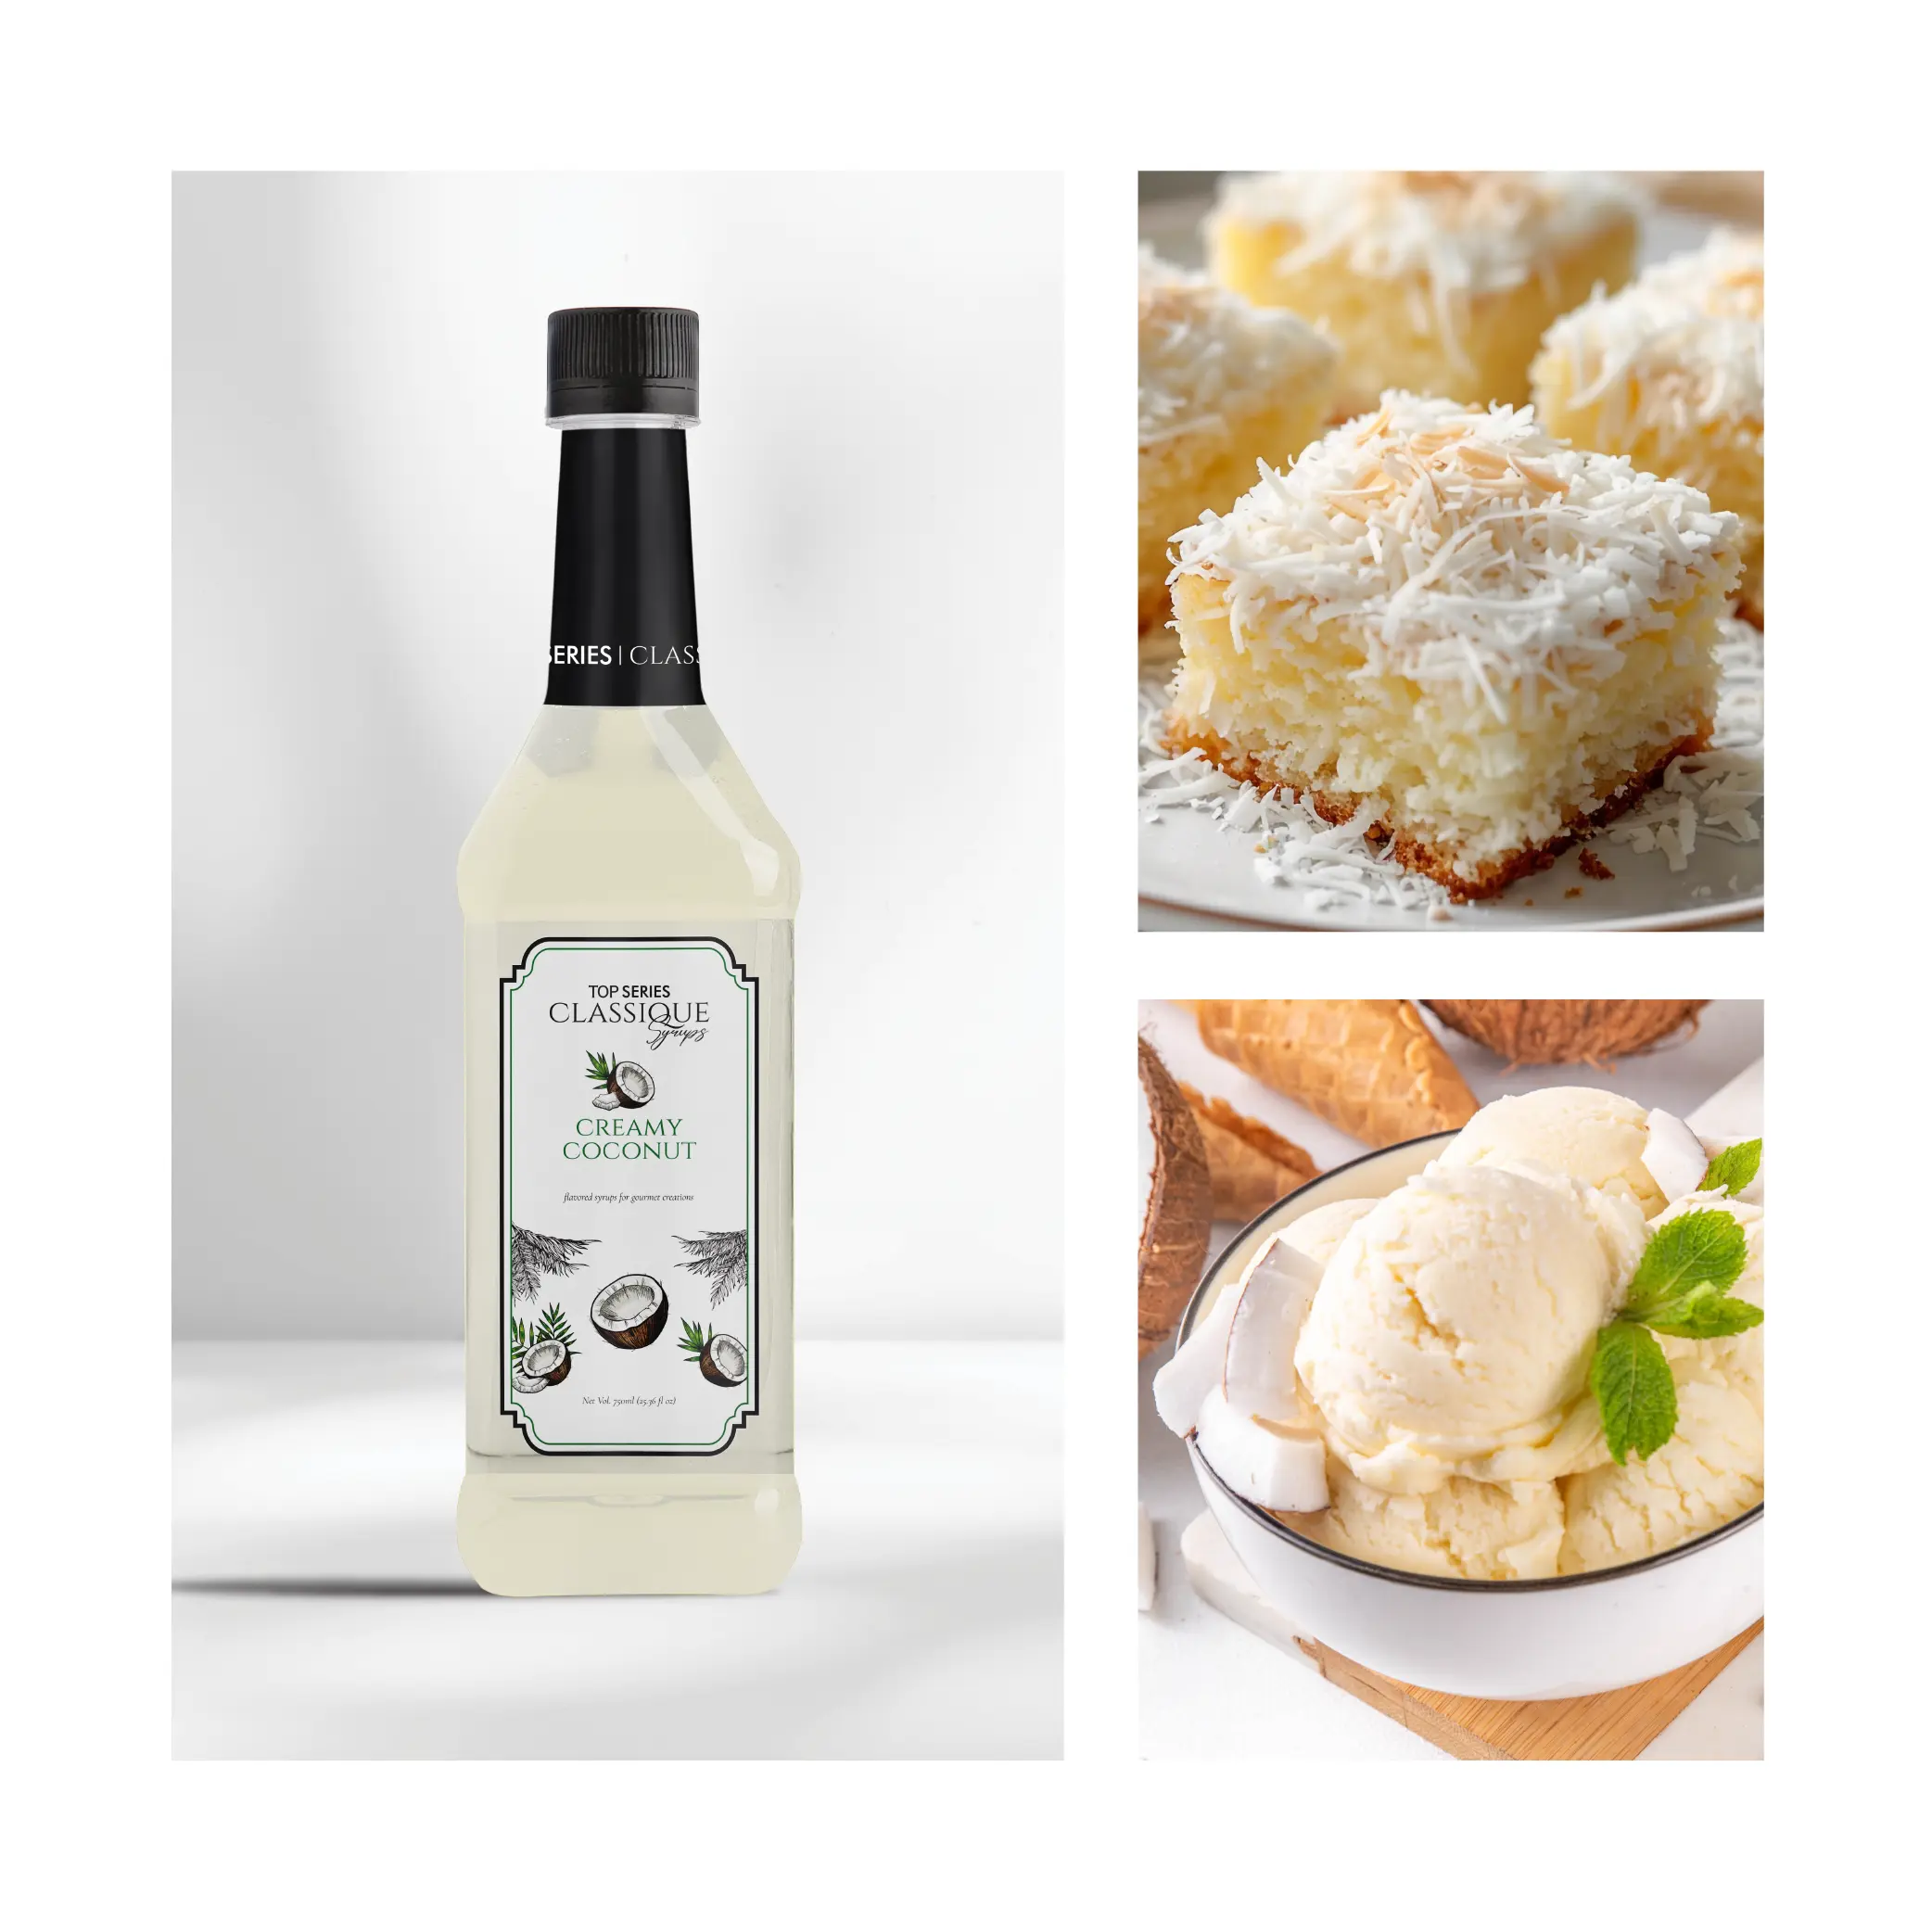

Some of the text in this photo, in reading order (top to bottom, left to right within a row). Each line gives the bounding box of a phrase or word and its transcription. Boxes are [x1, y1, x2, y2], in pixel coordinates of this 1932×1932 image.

[588, 985, 671, 998] TOP SERIES
[549, 1001, 710, 1028] CLASSIQUE
[645, 1014, 709, 1050] Syrups
[576, 1118, 683, 1137] CREAMY
[563, 1141, 697, 1160] COCONUT
[563, 1191, 694, 1203] flavored syrups for gourmet creations
[582, 1395, 677, 1406] Net Vol. 750ml (25.36 fl oz)
